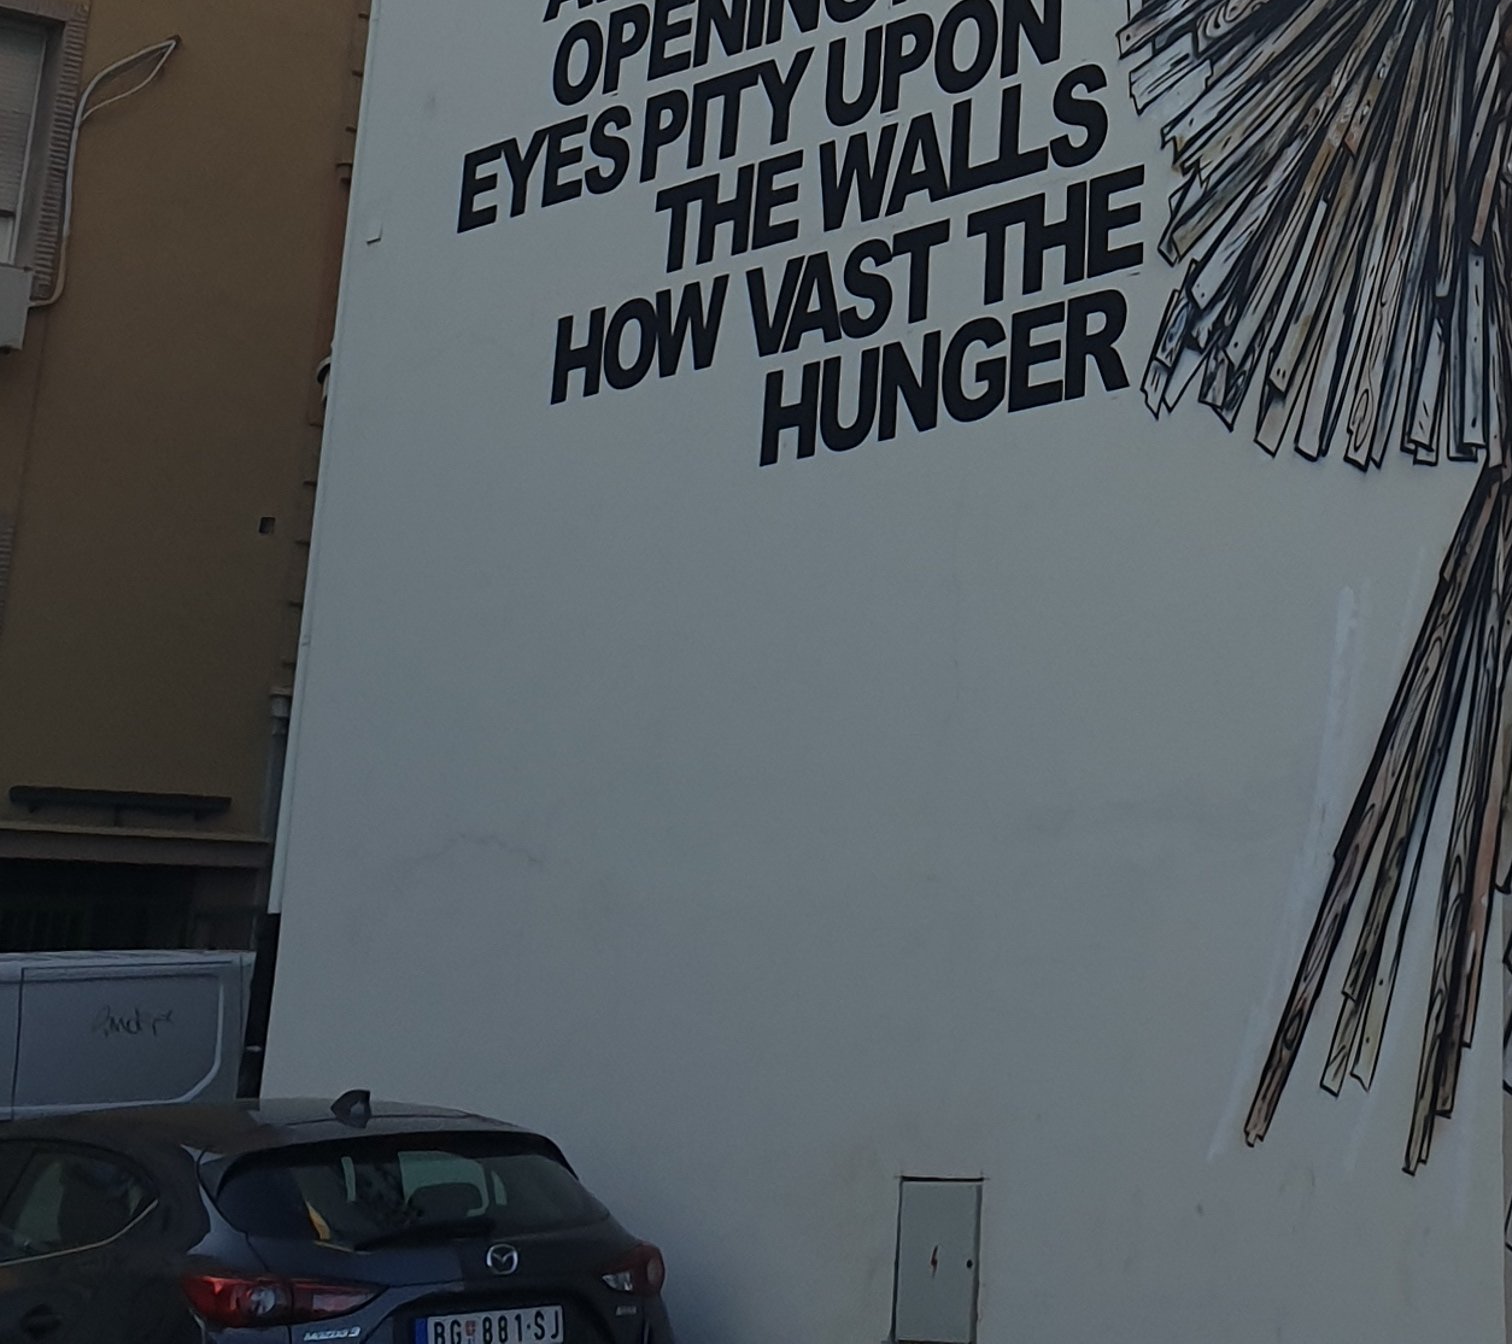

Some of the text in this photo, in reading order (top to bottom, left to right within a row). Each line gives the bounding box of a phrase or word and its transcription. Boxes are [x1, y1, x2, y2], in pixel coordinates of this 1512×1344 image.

[456, 105, 632, 234] EYES
[639, 46, 815, 184] PITY
[655, 63, 1109, 274] THE WALLS
[550, 164, 1145, 406] HOW VAST THE
[759, 289, 1131, 468] HUNGER
